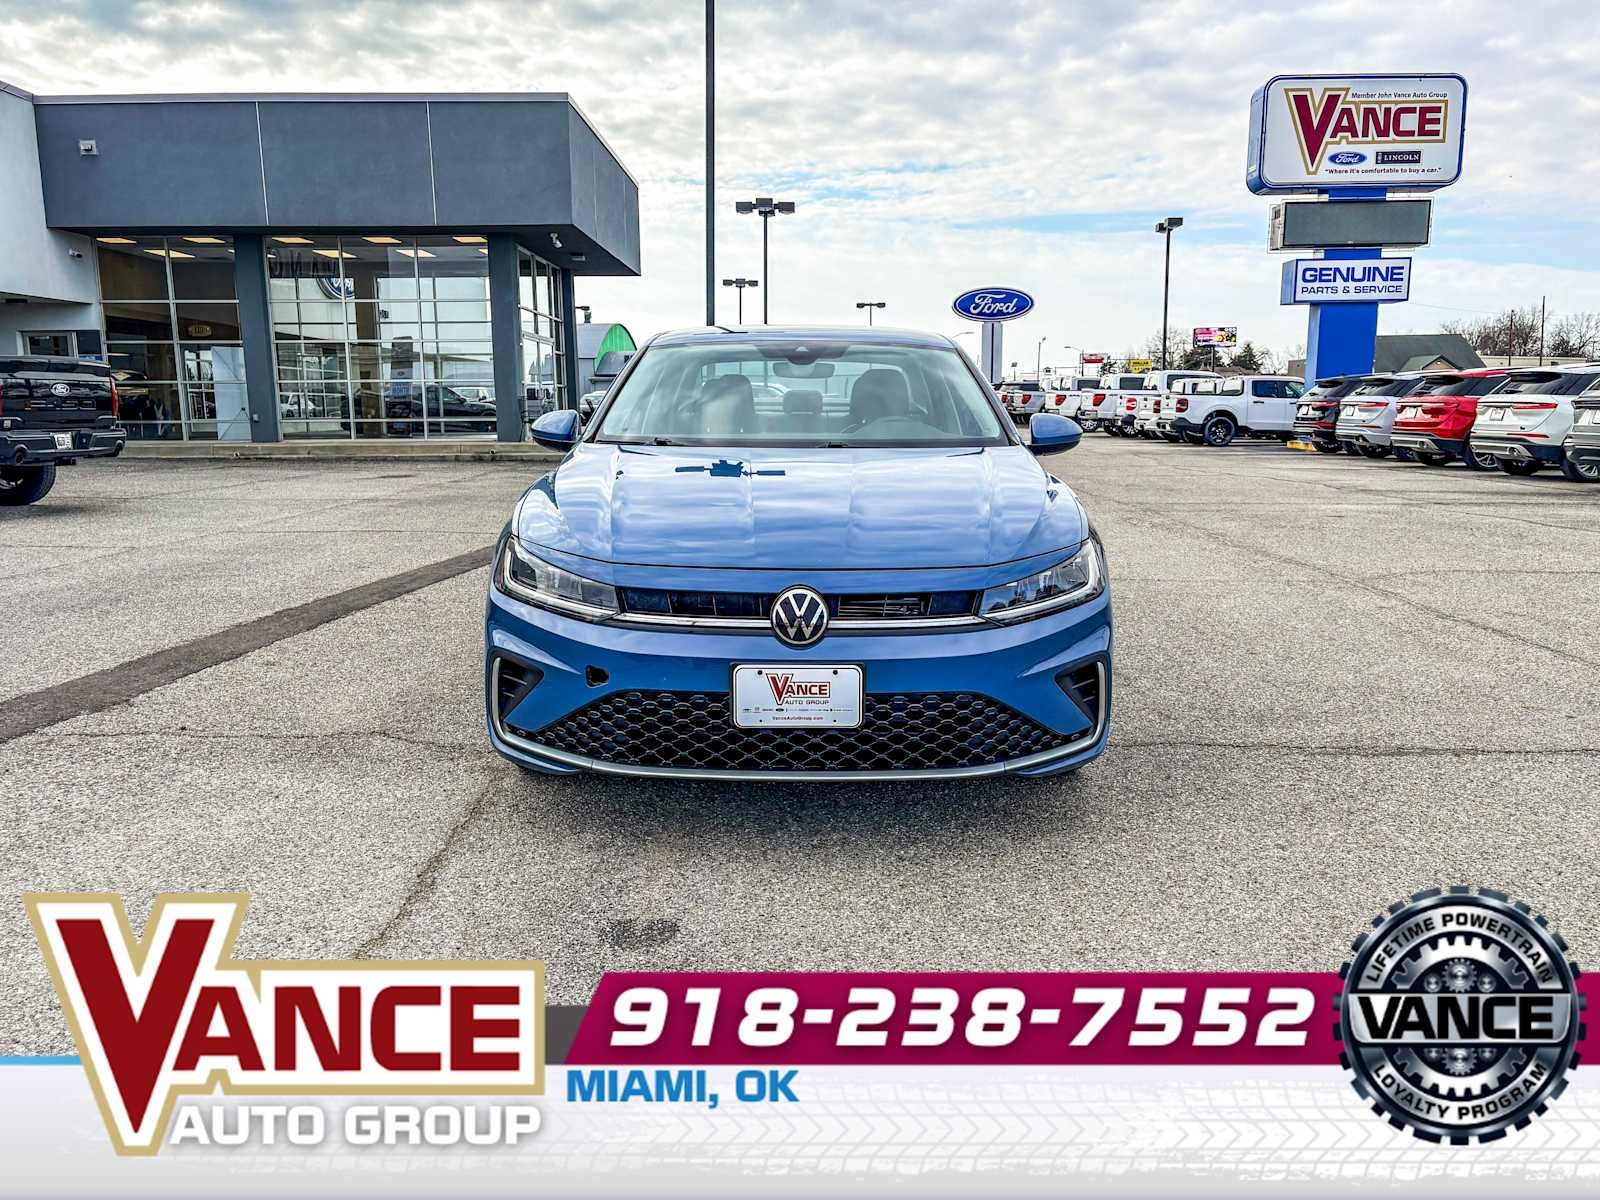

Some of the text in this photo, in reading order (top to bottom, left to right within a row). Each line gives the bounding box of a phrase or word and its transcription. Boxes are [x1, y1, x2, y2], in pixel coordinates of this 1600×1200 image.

[1351, 91, 1377, 99] Member
[1428, 90, 1448, 99] Group
[1291, 93, 1443, 167] VANCE
[1335, 153, 1360, 163] Ford
[1302, 266, 1404, 283] GENUINE
[1301, 285, 1403, 294] PARTS & SERVICE
[970, 293, 1018, 314] Ford
[769, 674, 829, 703] VANCE
